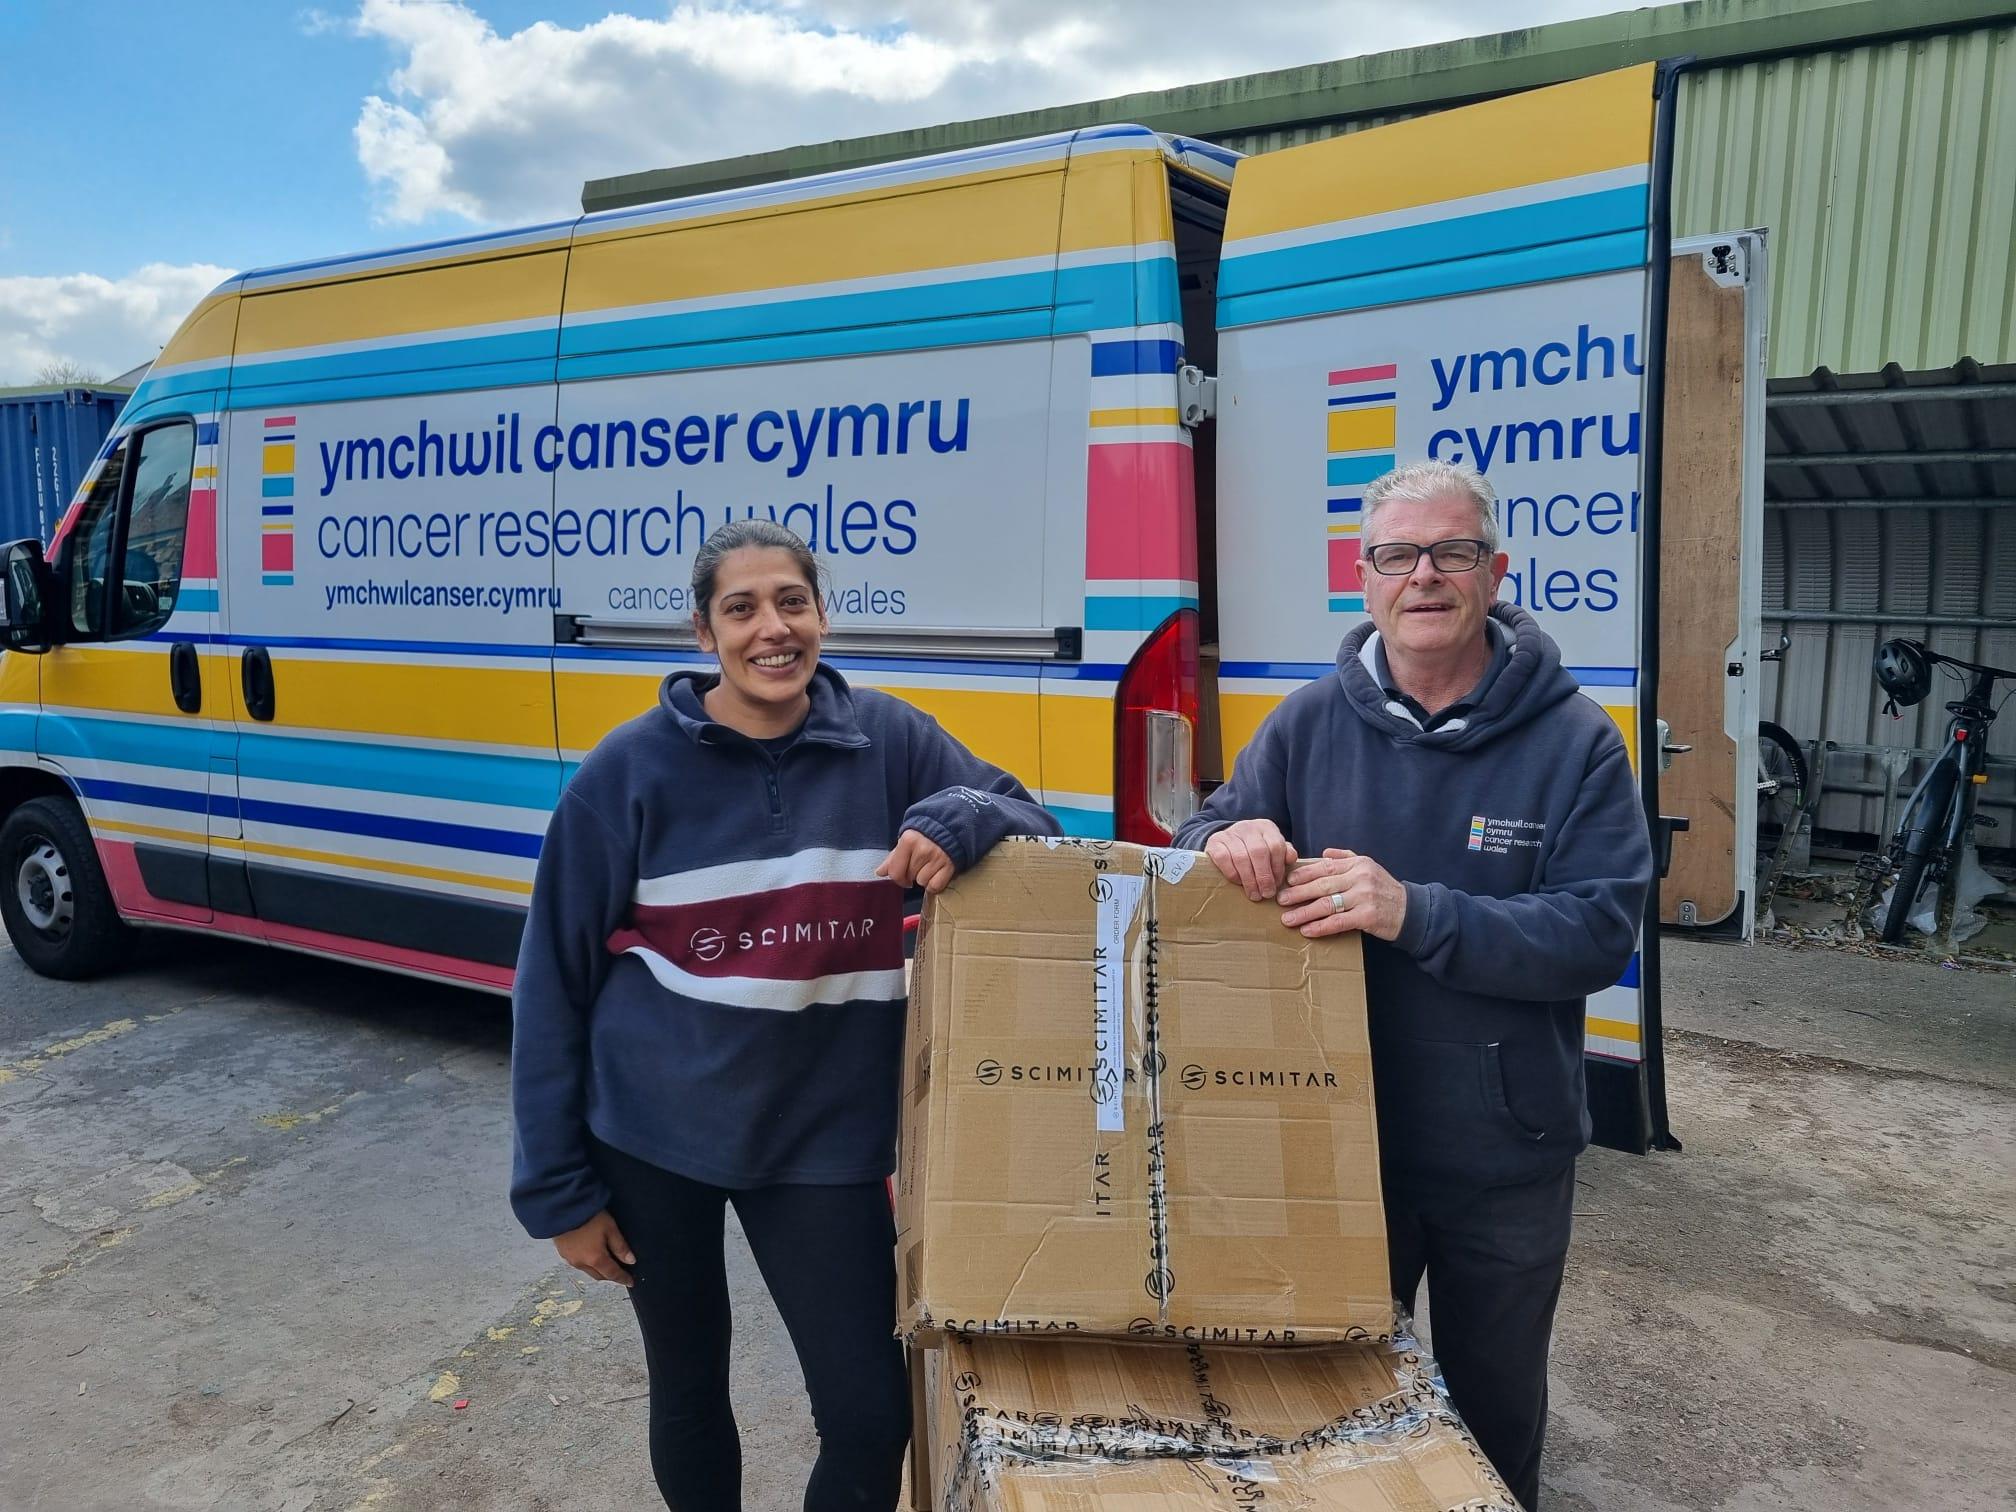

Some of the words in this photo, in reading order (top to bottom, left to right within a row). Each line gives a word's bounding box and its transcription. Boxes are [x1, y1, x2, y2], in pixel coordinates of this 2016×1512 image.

[319, 412, 523, 496] ymchwil
[534, 413, 738, 473] canser
[747, 398, 970, 478] cymru
[317, 513, 471, 559] cancer
[479, 489, 705, 558] research
[725, 484, 917, 555] ales
[1498, 557, 1619, 612] ales
[325, 579, 562, 614] ymchwilcanser.cymru
[1486, 827, 1513, 836] cymru
[1487, 818, 1523, 829] ymchwil
[1483, 846, 1508, 854] wales
[1484, 836, 1512, 846] cancer
[738, 918, 874, 950] SCIMITAR
[1093, 946, 1108, 1070] SCIMITAR
[1012, 1065, 1137, 1083] SCIMITAR
[1215, 1070, 1339, 1088] SCIMITAR
[1164, 1324, 1297, 1342] SCIMITAR
